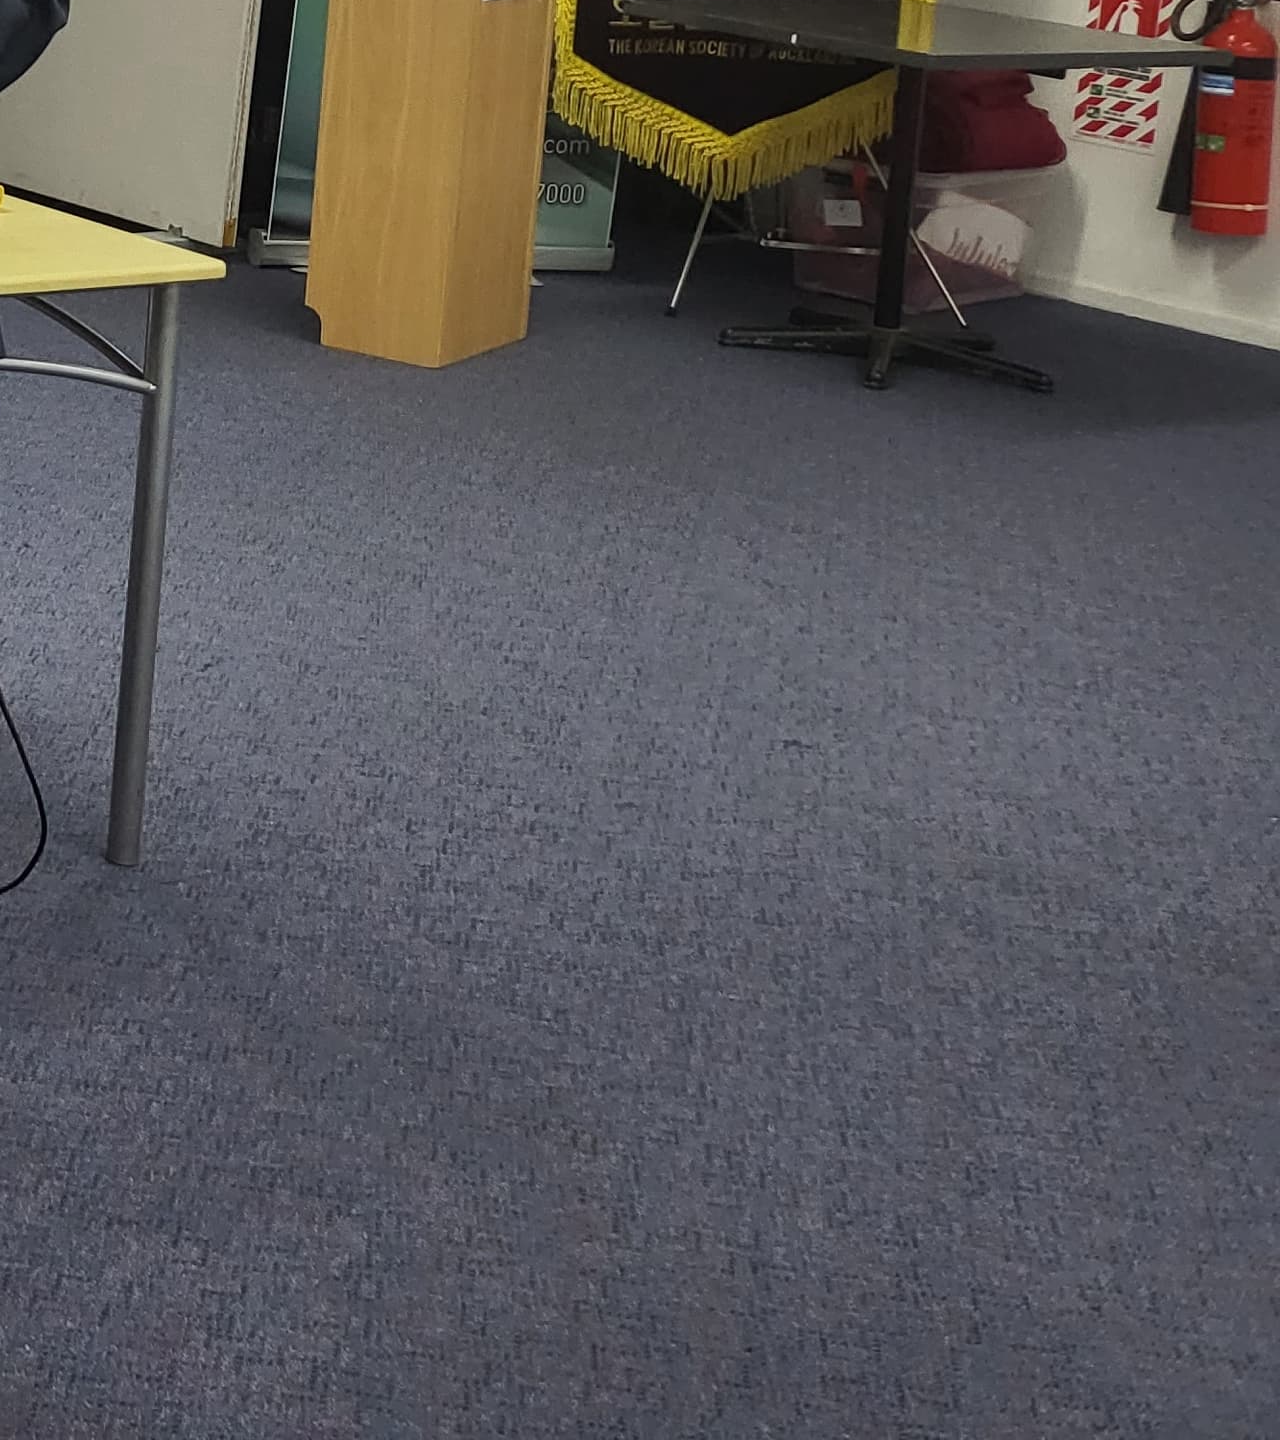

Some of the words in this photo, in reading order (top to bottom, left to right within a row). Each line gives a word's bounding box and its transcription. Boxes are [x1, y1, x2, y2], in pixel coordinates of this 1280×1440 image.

[608, 38, 631, 55] THE
[634, 38, 685, 56] KOREAN
[688, 41, 746, 58] SOCIETY
